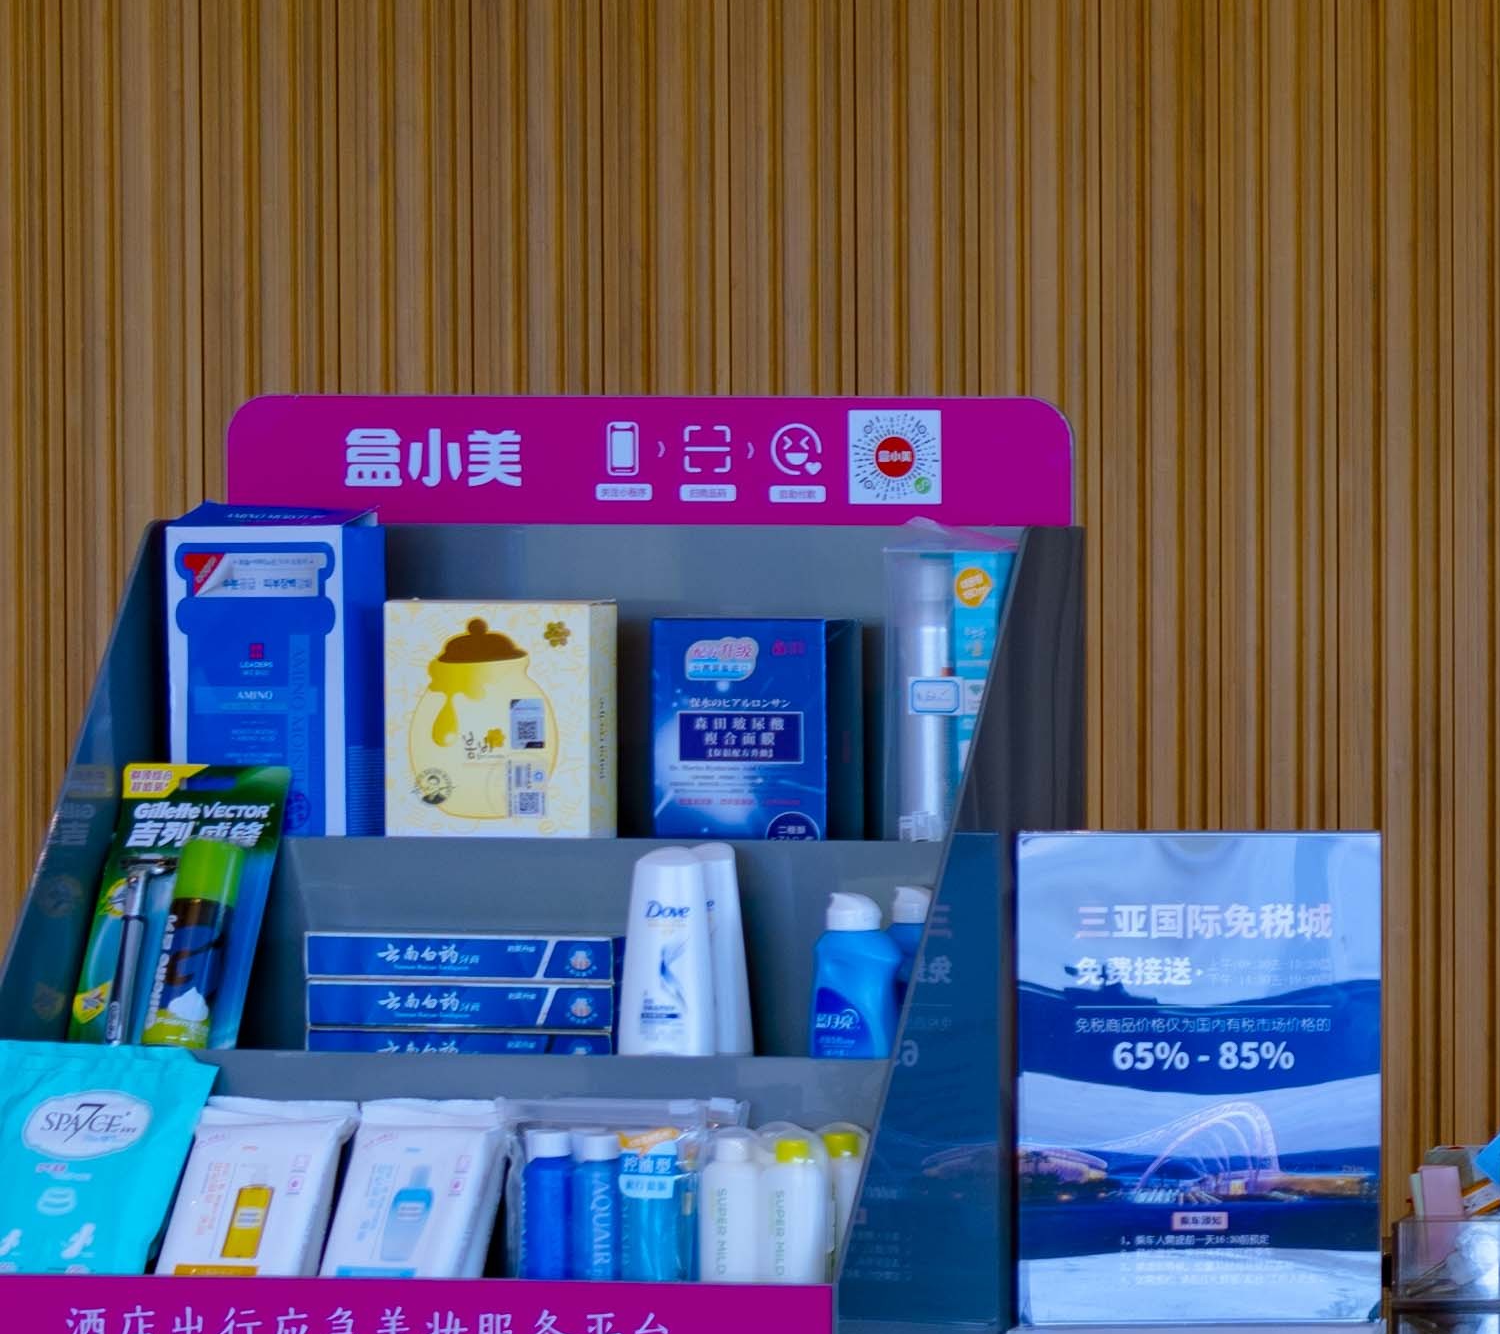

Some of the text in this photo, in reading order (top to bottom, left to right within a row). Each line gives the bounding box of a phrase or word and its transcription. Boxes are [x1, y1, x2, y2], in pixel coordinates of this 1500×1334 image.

[344, 427, 523, 488] 盒小美
[237, 690, 273, 700] AMINO
[133, 800, 271, 820] Gillette VECTOR
[124, 820, 196, 848] 吉列
[643, 900, 690, 918] Dove
[1074, 902, 1334, 941] 三亚国际免税城
[376, 943, 460, 965] 云南白药
[1075, 956, 1192, 987] 免费接送
[377, 990, 461, 1012] 云南白药
[1074, 1017, 1332, 1034] 免税商品价格仅为国内有税市场价格的
[1112, 1041, 1190, 1071] 65%
[1218, 1041, 1295, 1071] 85%
[715, 1187, 728, 1276] SUPER MILD
[775, 1189, 785, 1276] SUPER MILD
